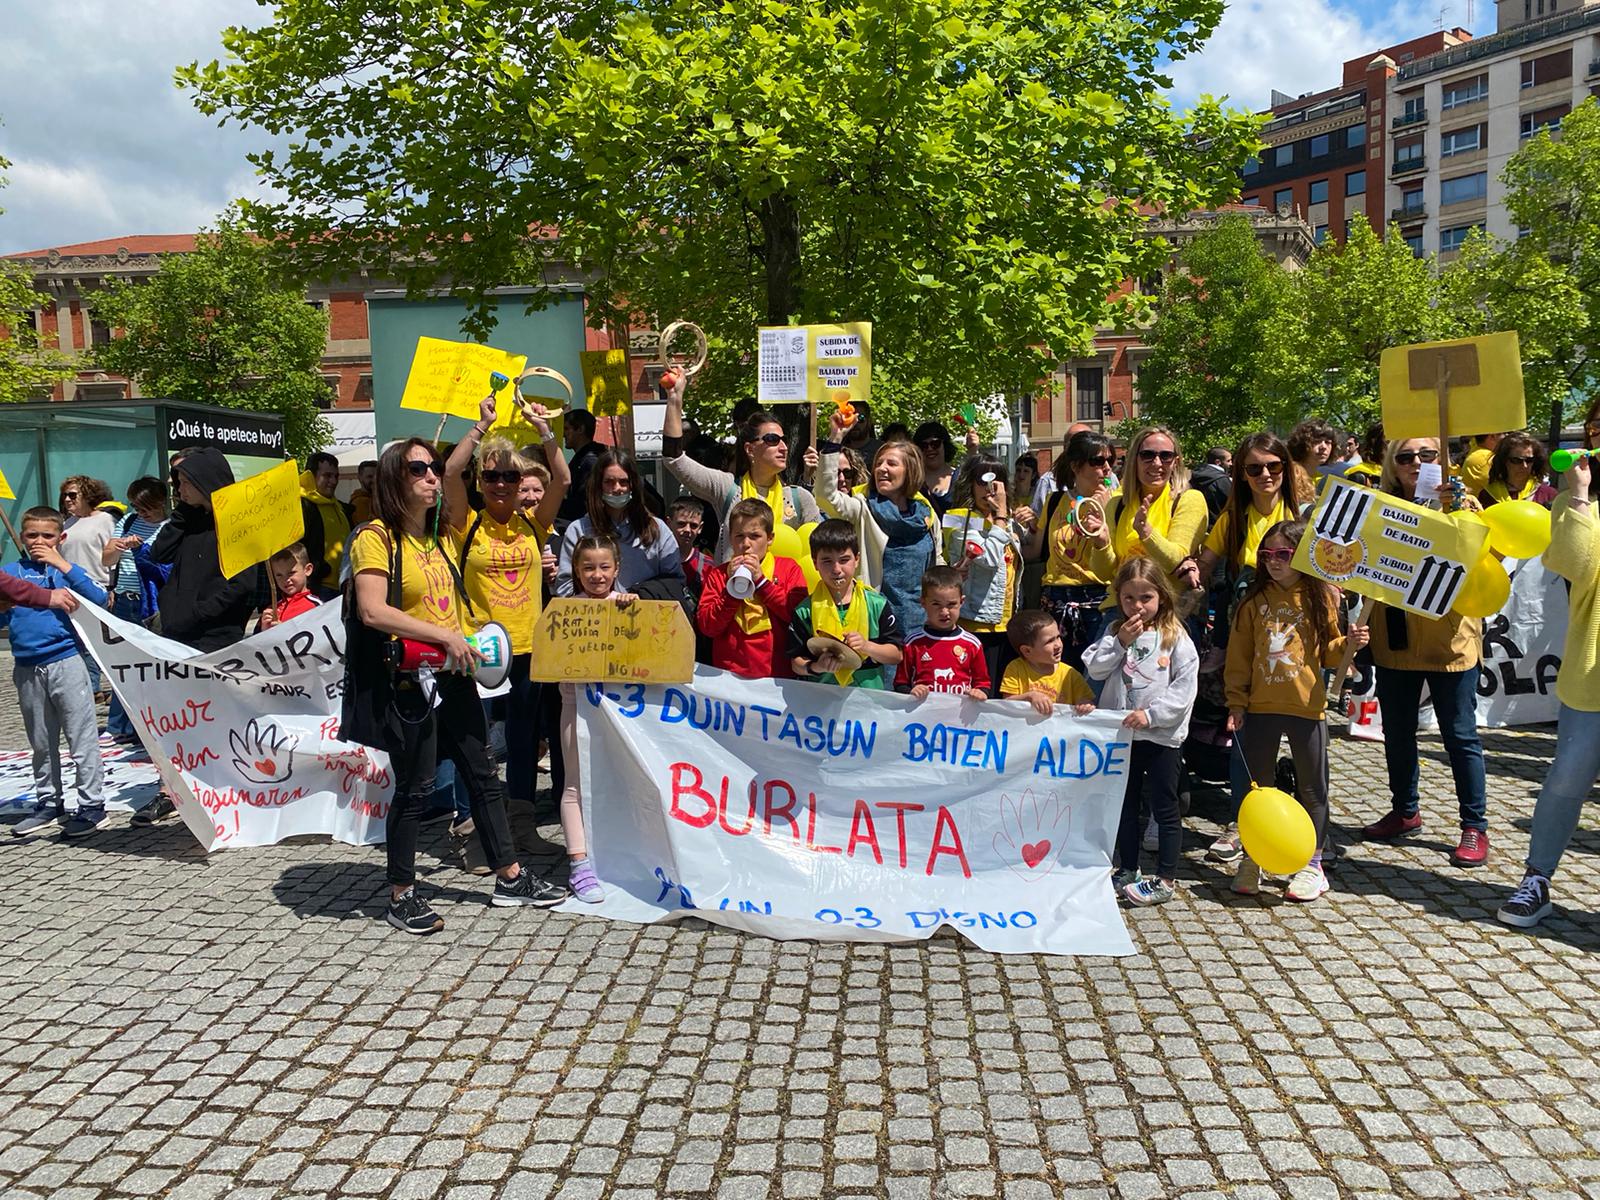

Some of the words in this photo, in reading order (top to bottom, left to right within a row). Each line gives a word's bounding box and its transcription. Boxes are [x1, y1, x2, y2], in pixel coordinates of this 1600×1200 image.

[819, 337, 846, 346] SUBIDA
[848, 337, 860, 345] DE
[824, 348, 853, 356] SUELDO
[819, 368, 846, 376] BAJADA
[169, 419, 200, 440] ¿Qué
[202, 423, 214, 439] te
[217, 427, 258, 444] apetece
[260, 429, 282, 448] hoy?
[1382, 508, 1419, 527] BAJADA
[1384, 528, 1400, 540] DE
[1400, 533, 1430, 549] RATIO
[1378, 556, 1414, 574] SUBIDA
[1356, 566, 1370, 578] DE
[1371, 571, 1410, 589] SUELDO
[563, 604, 607, 616] BAJADA
[562, 618, 600, 628] RATIO
[567, 643, 615, 655] SUELDO
[902, 722, 1009, 775] BATEN
[1033, 736, 1130, 779] ALDE
[668, 761, 972, 879] BURLATA
[815, 907, 882, 929] 0-3
[906, 907, 1038, 930] DIGNO
